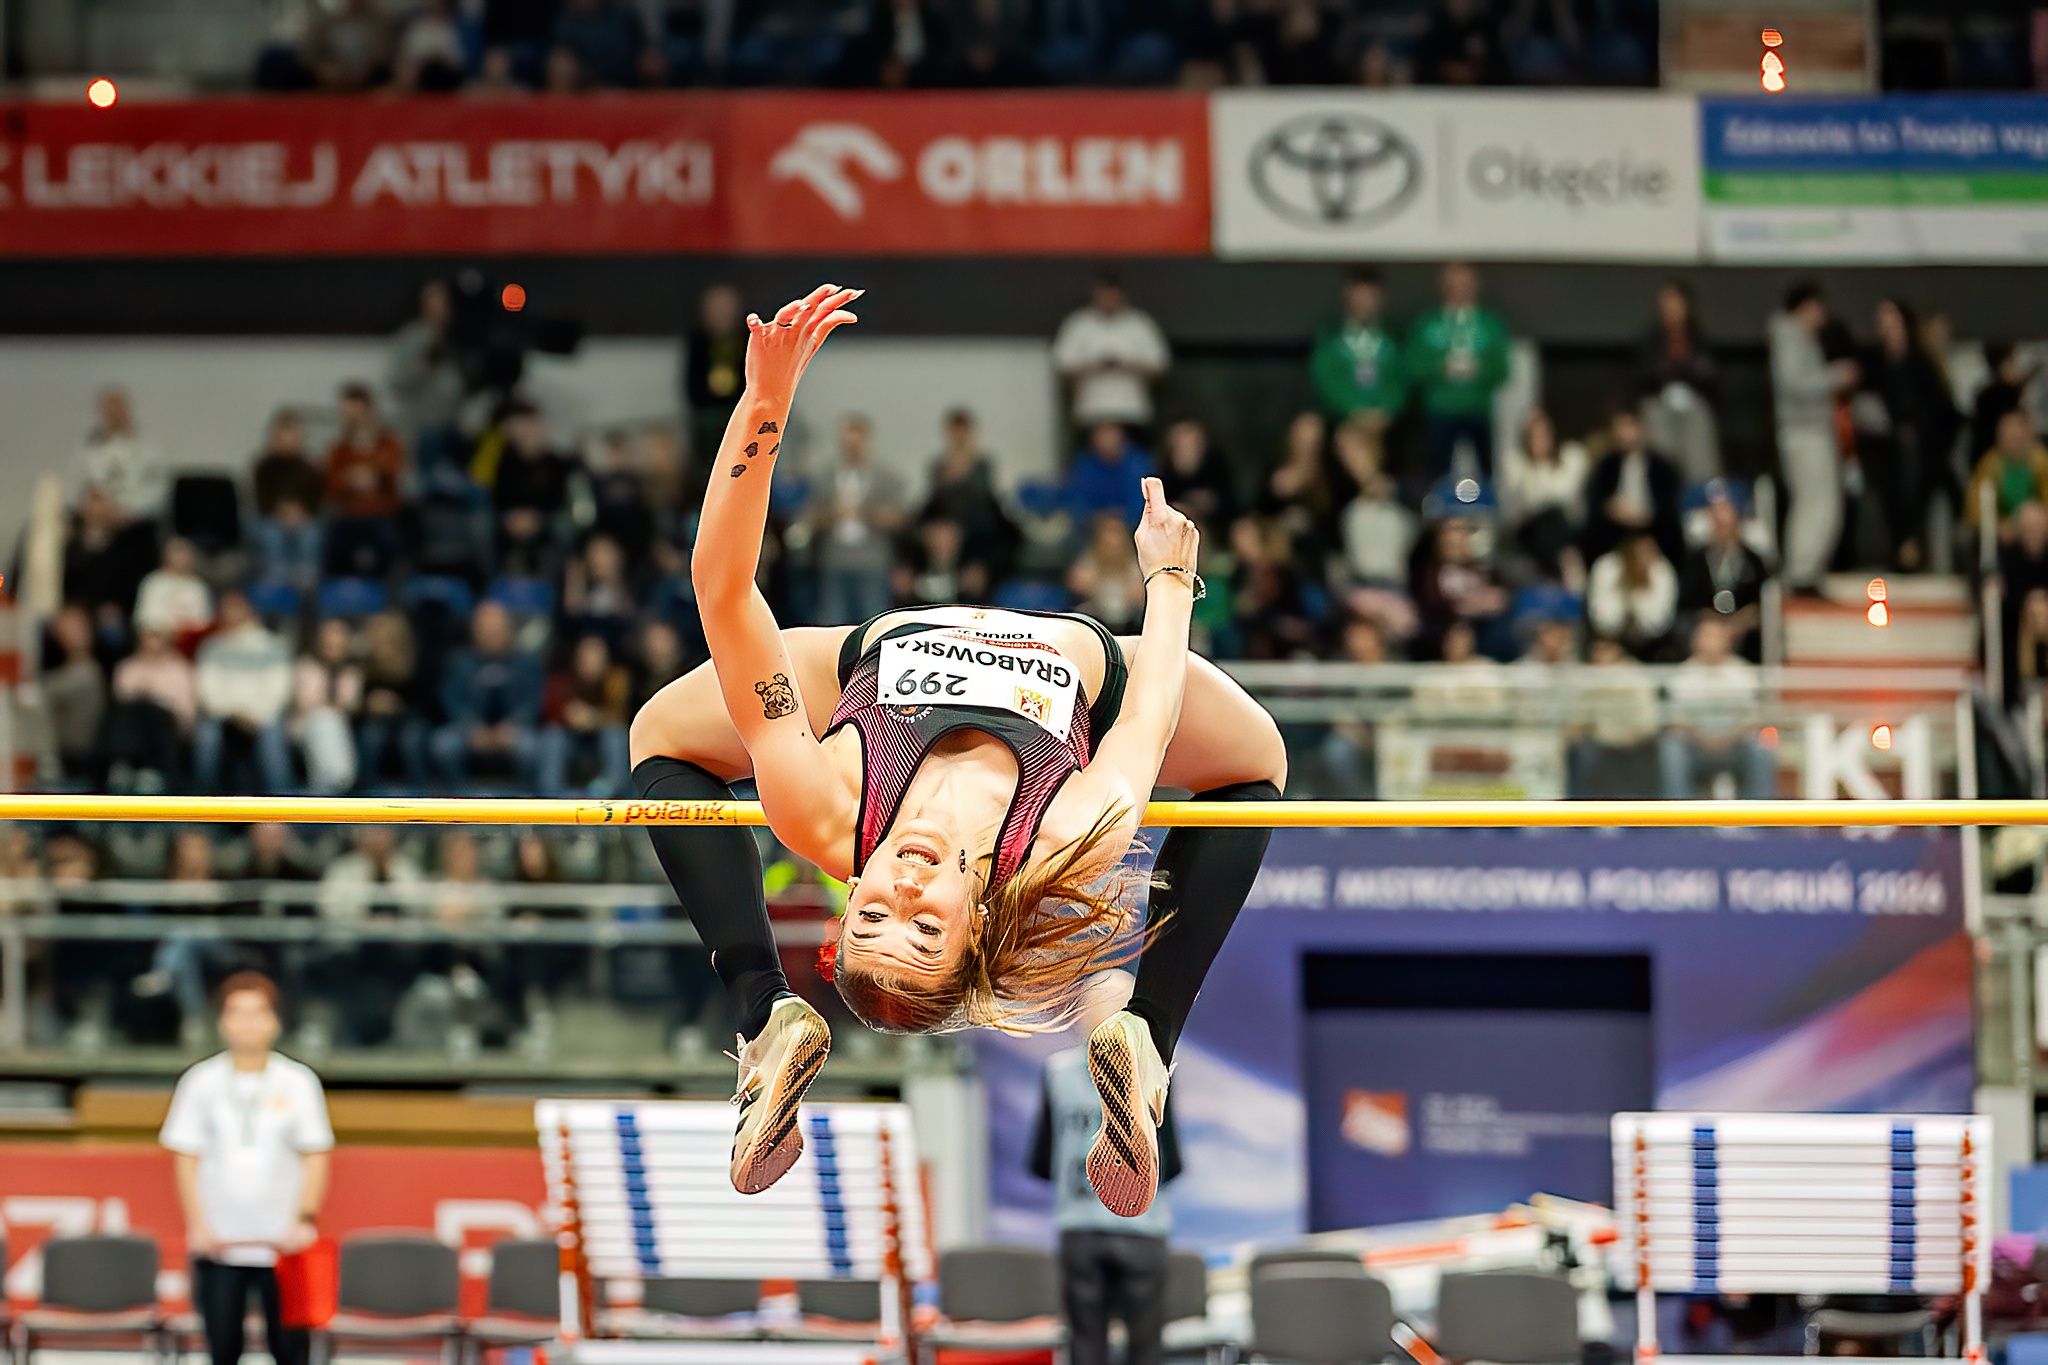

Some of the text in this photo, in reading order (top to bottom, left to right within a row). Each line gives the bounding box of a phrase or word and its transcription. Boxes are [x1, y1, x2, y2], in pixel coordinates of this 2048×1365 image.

[22, 140, 340, 208] LEKKIEJ
[351, 138, 716, 206] ATLETYKI
[917, 136, 1186, 208] ORLEN
[896, 668, 968, 696] 299
[1804, 711, 1933, 800] K1
[624, 801, 725, 823] polanik
